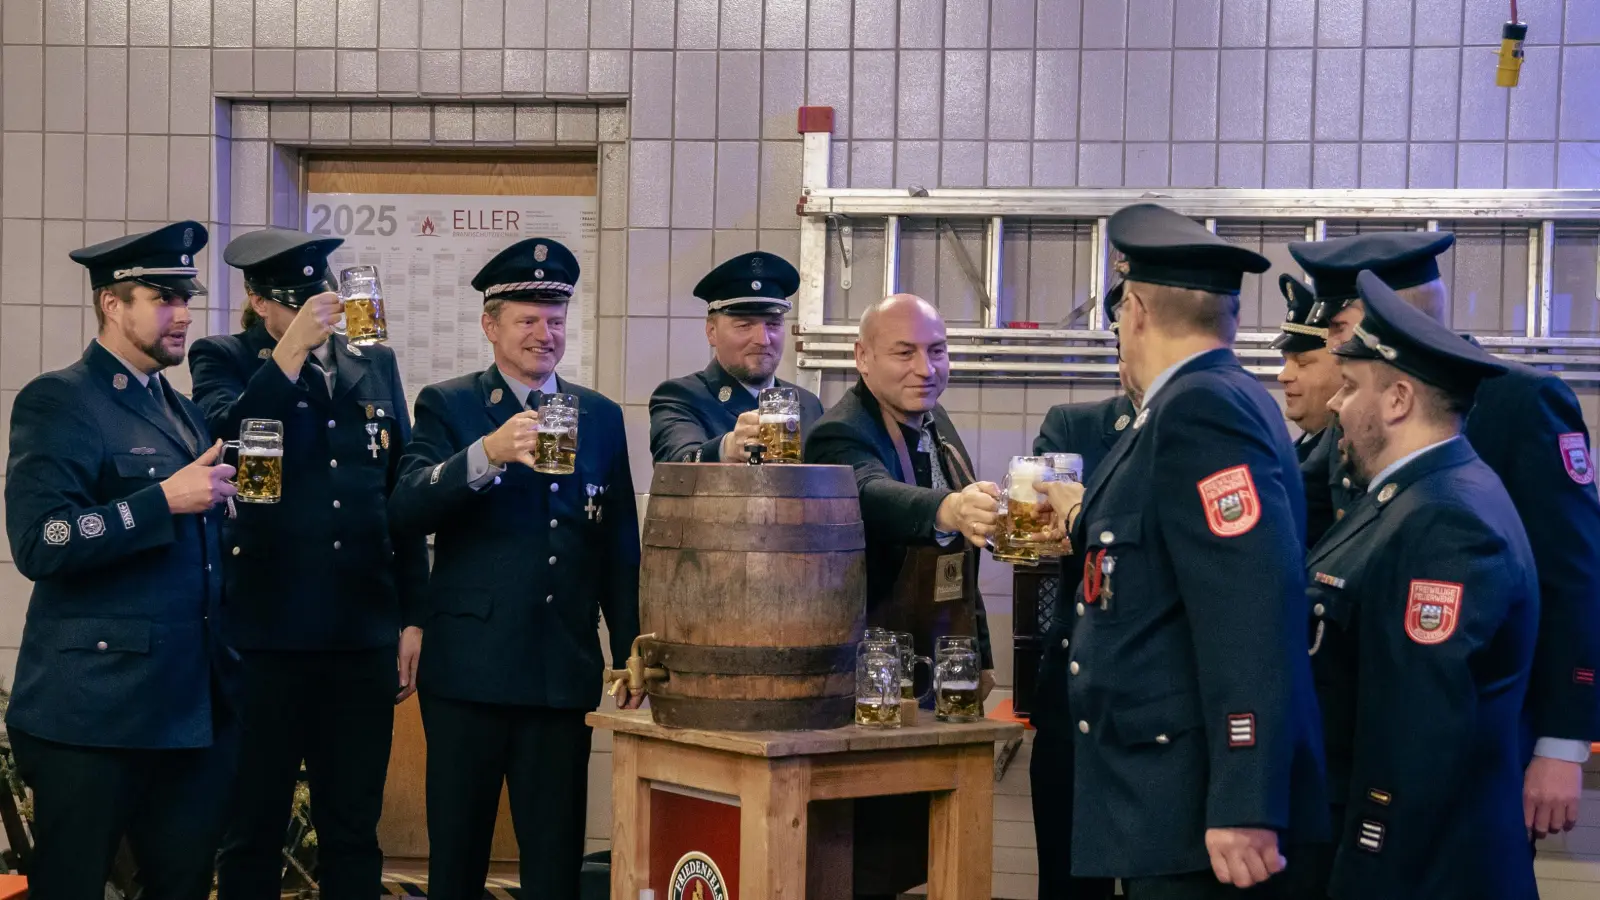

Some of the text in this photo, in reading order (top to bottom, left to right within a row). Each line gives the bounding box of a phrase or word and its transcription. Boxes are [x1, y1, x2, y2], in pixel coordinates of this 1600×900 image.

[312, 204, 397, 236] 2025
[453, 210, 519, 230] ELLER
[1415, 585, 1456, 595] FREIWILLIGE
[1414, 593, 1455, 603] FEUERWEHR
